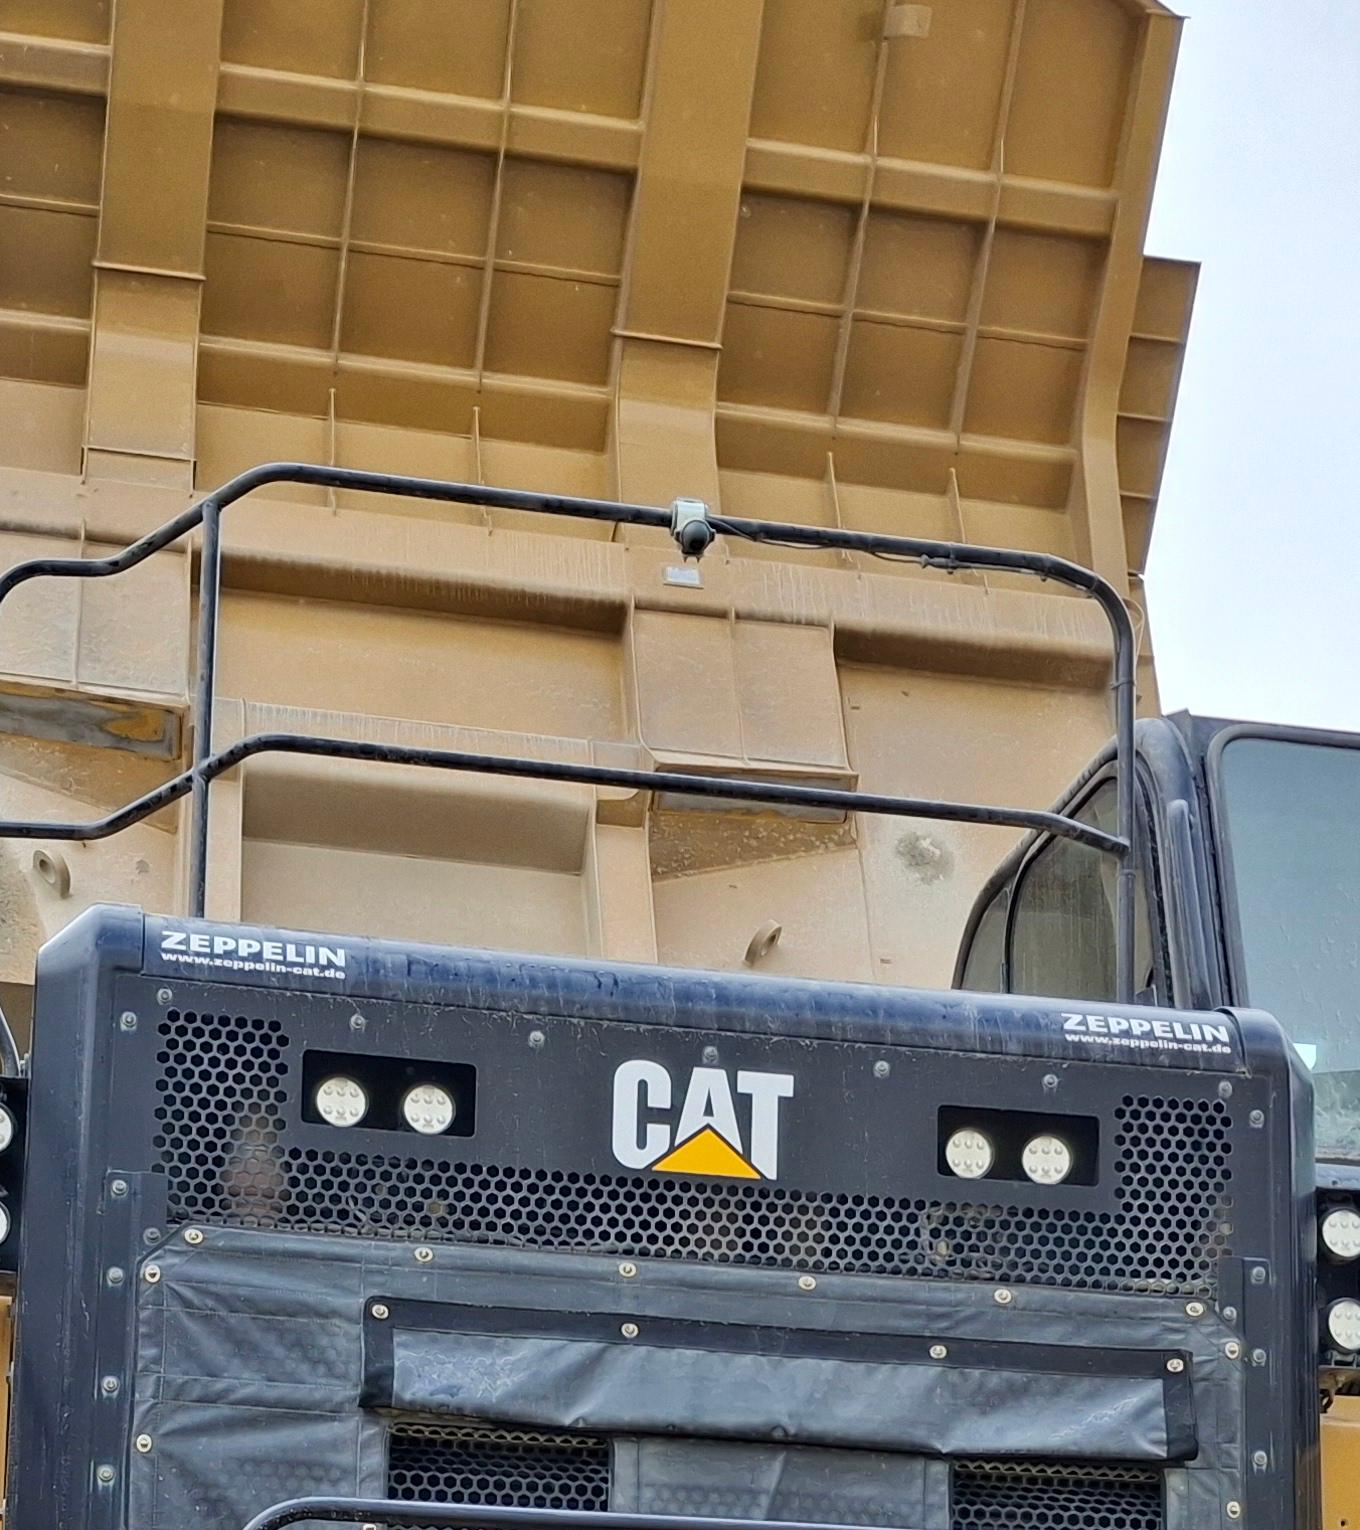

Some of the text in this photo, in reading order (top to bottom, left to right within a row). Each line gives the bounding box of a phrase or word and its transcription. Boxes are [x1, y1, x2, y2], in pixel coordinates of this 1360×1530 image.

[160, 930, 346, 967] ZEPPELIN
[160, 952, 346, 979] www.zeppelin-cat.de
[1060, 1012, 1230, 1043] ZEPPELIN
[1064, 1033, 1232, 1054] www.zeppelin-cat.de
[612, 1059, 794, 1181] CAT
